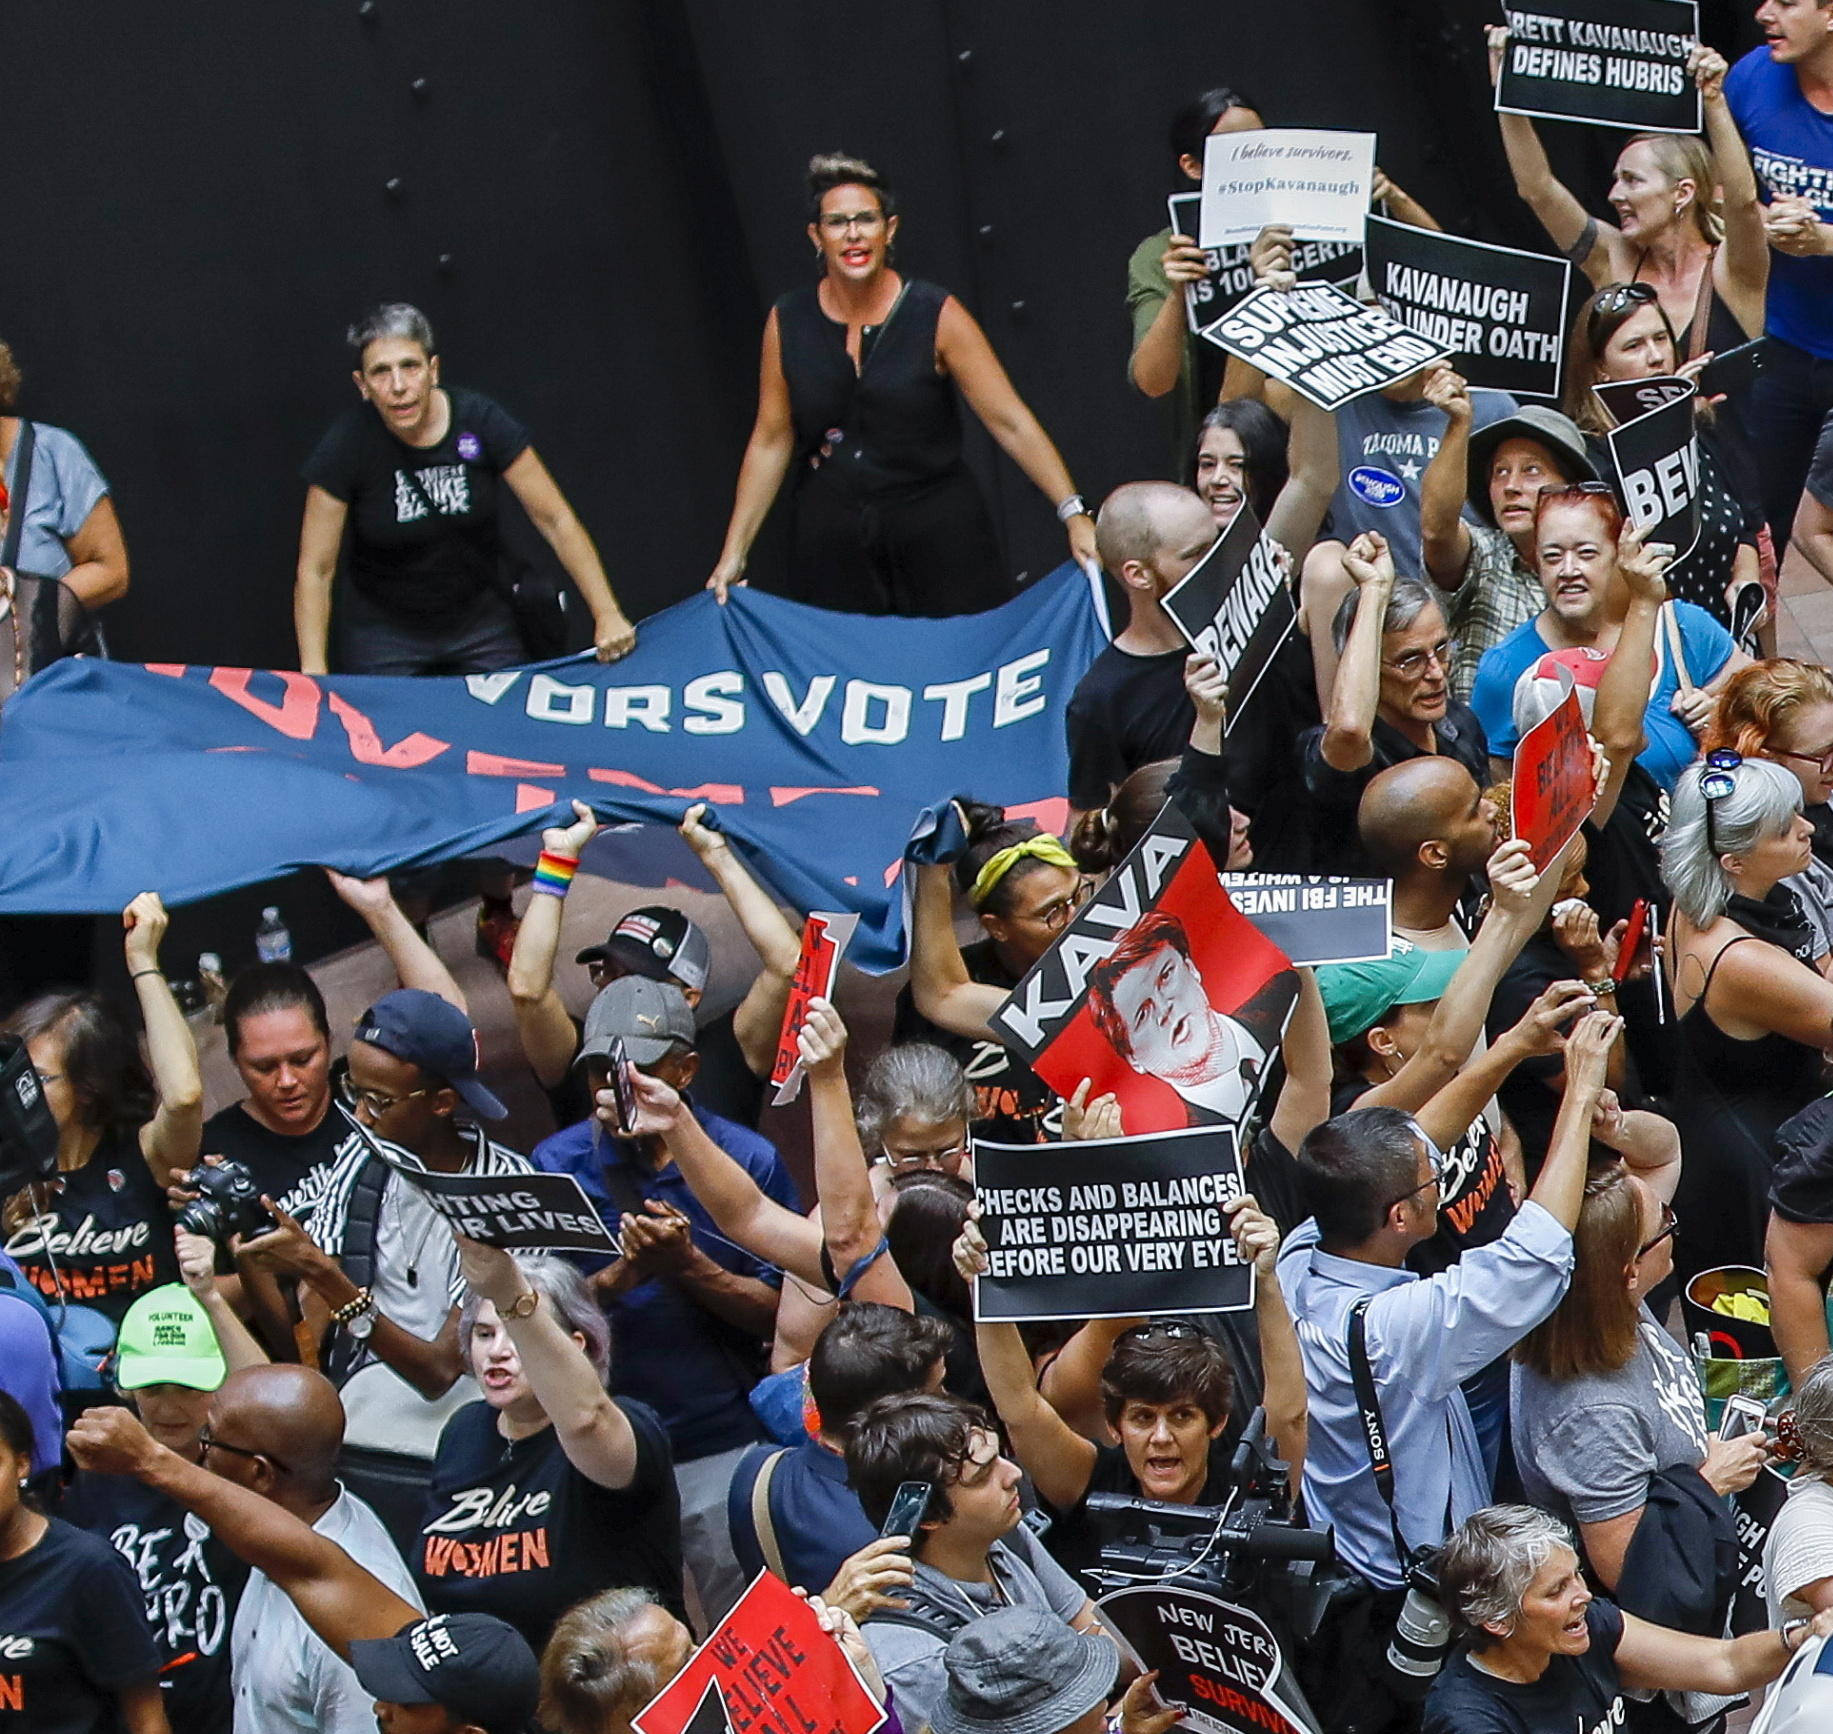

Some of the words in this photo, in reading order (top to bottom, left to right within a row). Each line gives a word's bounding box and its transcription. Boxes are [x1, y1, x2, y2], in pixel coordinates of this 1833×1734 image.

[1512, 45, 1601, 87] DEFINES
[1605, 60, 1684, 95] HUBRIS
[1217, 176, 1360, 197] #StopKavanaugh
[1385, 262, 1528, 325] KAVANAUGH
[1251, 308, 1404, 375] INJUSTICE
[1488, 327, 1558, 362] OATH
[1300, 354, 1370, 399] MUST
[1370, 334, 1438, 375] END
[762, 648, 1050, 746] VOTE
[1301, 888, 1337, 911] FBI
[1343, 885, 1387, 908] THE
[1002, 834, 1188, 1050] KAVA
[975, 1187, 1063, 1218] CHECKS
[1068, 1183, 1117, 1213] AND
[1122, 1171, 1240, 1208] BALANCES
[3, 1211, 152, 1259] Believe
[501, 1207, 604, 1236] LIVES
[1001, 1215, 1046, 1246] ARE
[1053, 1207, 1221, 1243] DISAPPEARING
[1071, 1243, 1122, 1274] OUR
[1126, 1239, 1185, 1273] VERY
[1364, 1408, 1385, 1462] SONY
[110, 1522, 173, 1591] BE
[1159, 1604, 1214, 1634] NEW
[429, 1626, 460, 1660] NOT
